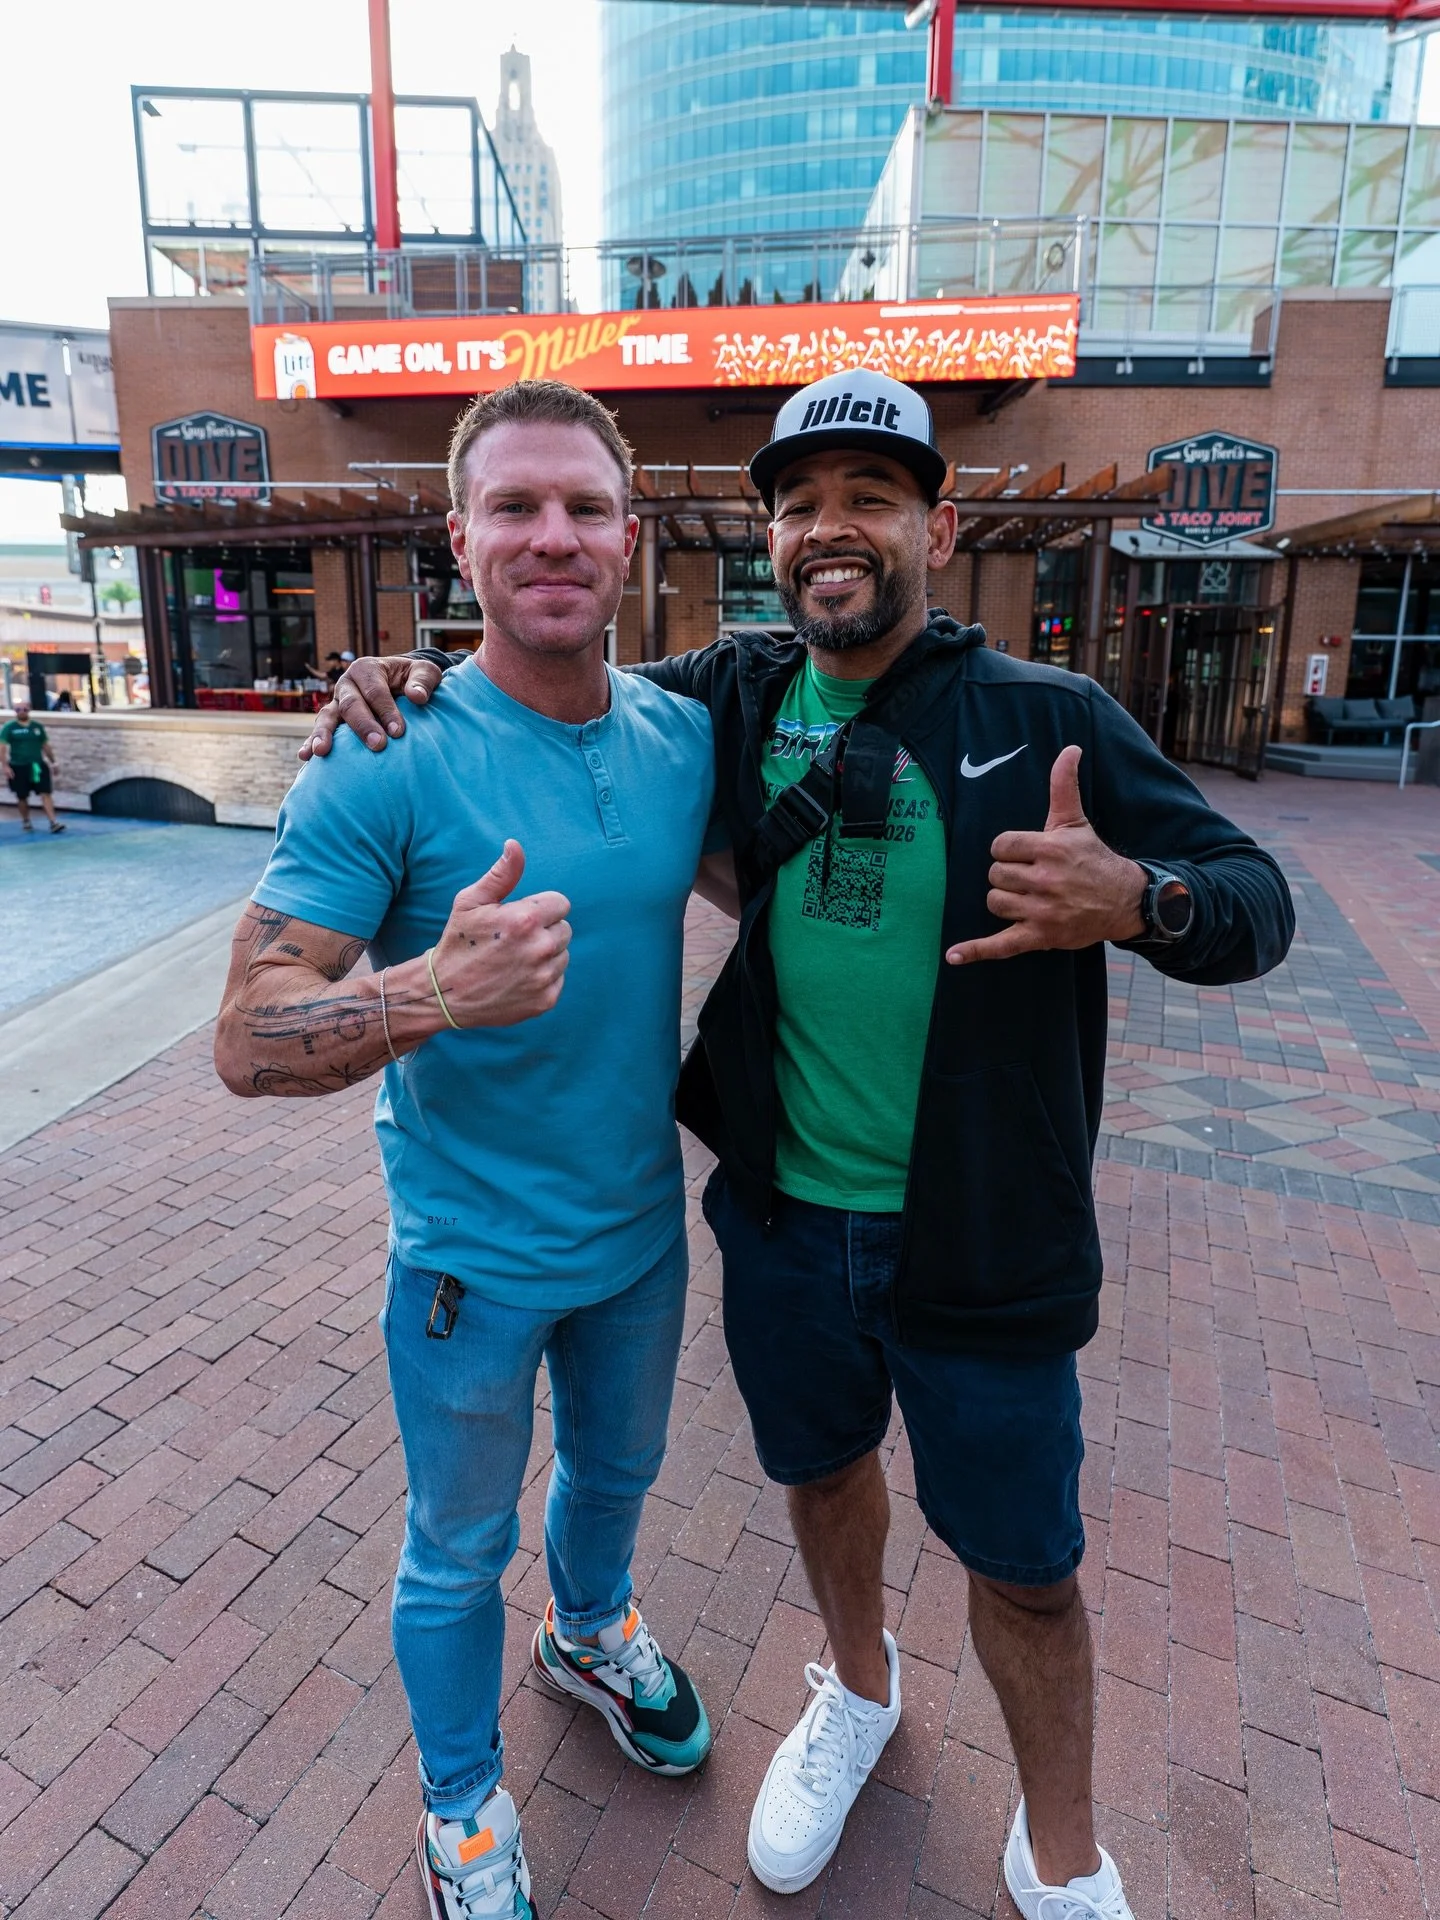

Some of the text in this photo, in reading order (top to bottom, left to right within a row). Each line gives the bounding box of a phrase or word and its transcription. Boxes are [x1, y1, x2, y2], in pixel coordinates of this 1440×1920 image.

[327, 344, 402, 375] GAME
[404, 342, 452, 374] ON,
[457, 340, 506, 371] IT'S
[500, 314, 641, 380] Miller
[800, 392, 901, 431] illicit
[181, 420, 206, 440] Guy
[160, 437, 260, 481] DIVE
[1183, 442, 1210, 463] Guy
[180, 485, 216, 497] TACO
[221, 485, 259, 498] JOINT
[1170, 511, 1213, 526] TACO
[1216, 512, 1263, 526] JOINT
[874, 824, 916, 842] 026
[427, 1215, 458, 1226] BYLT
